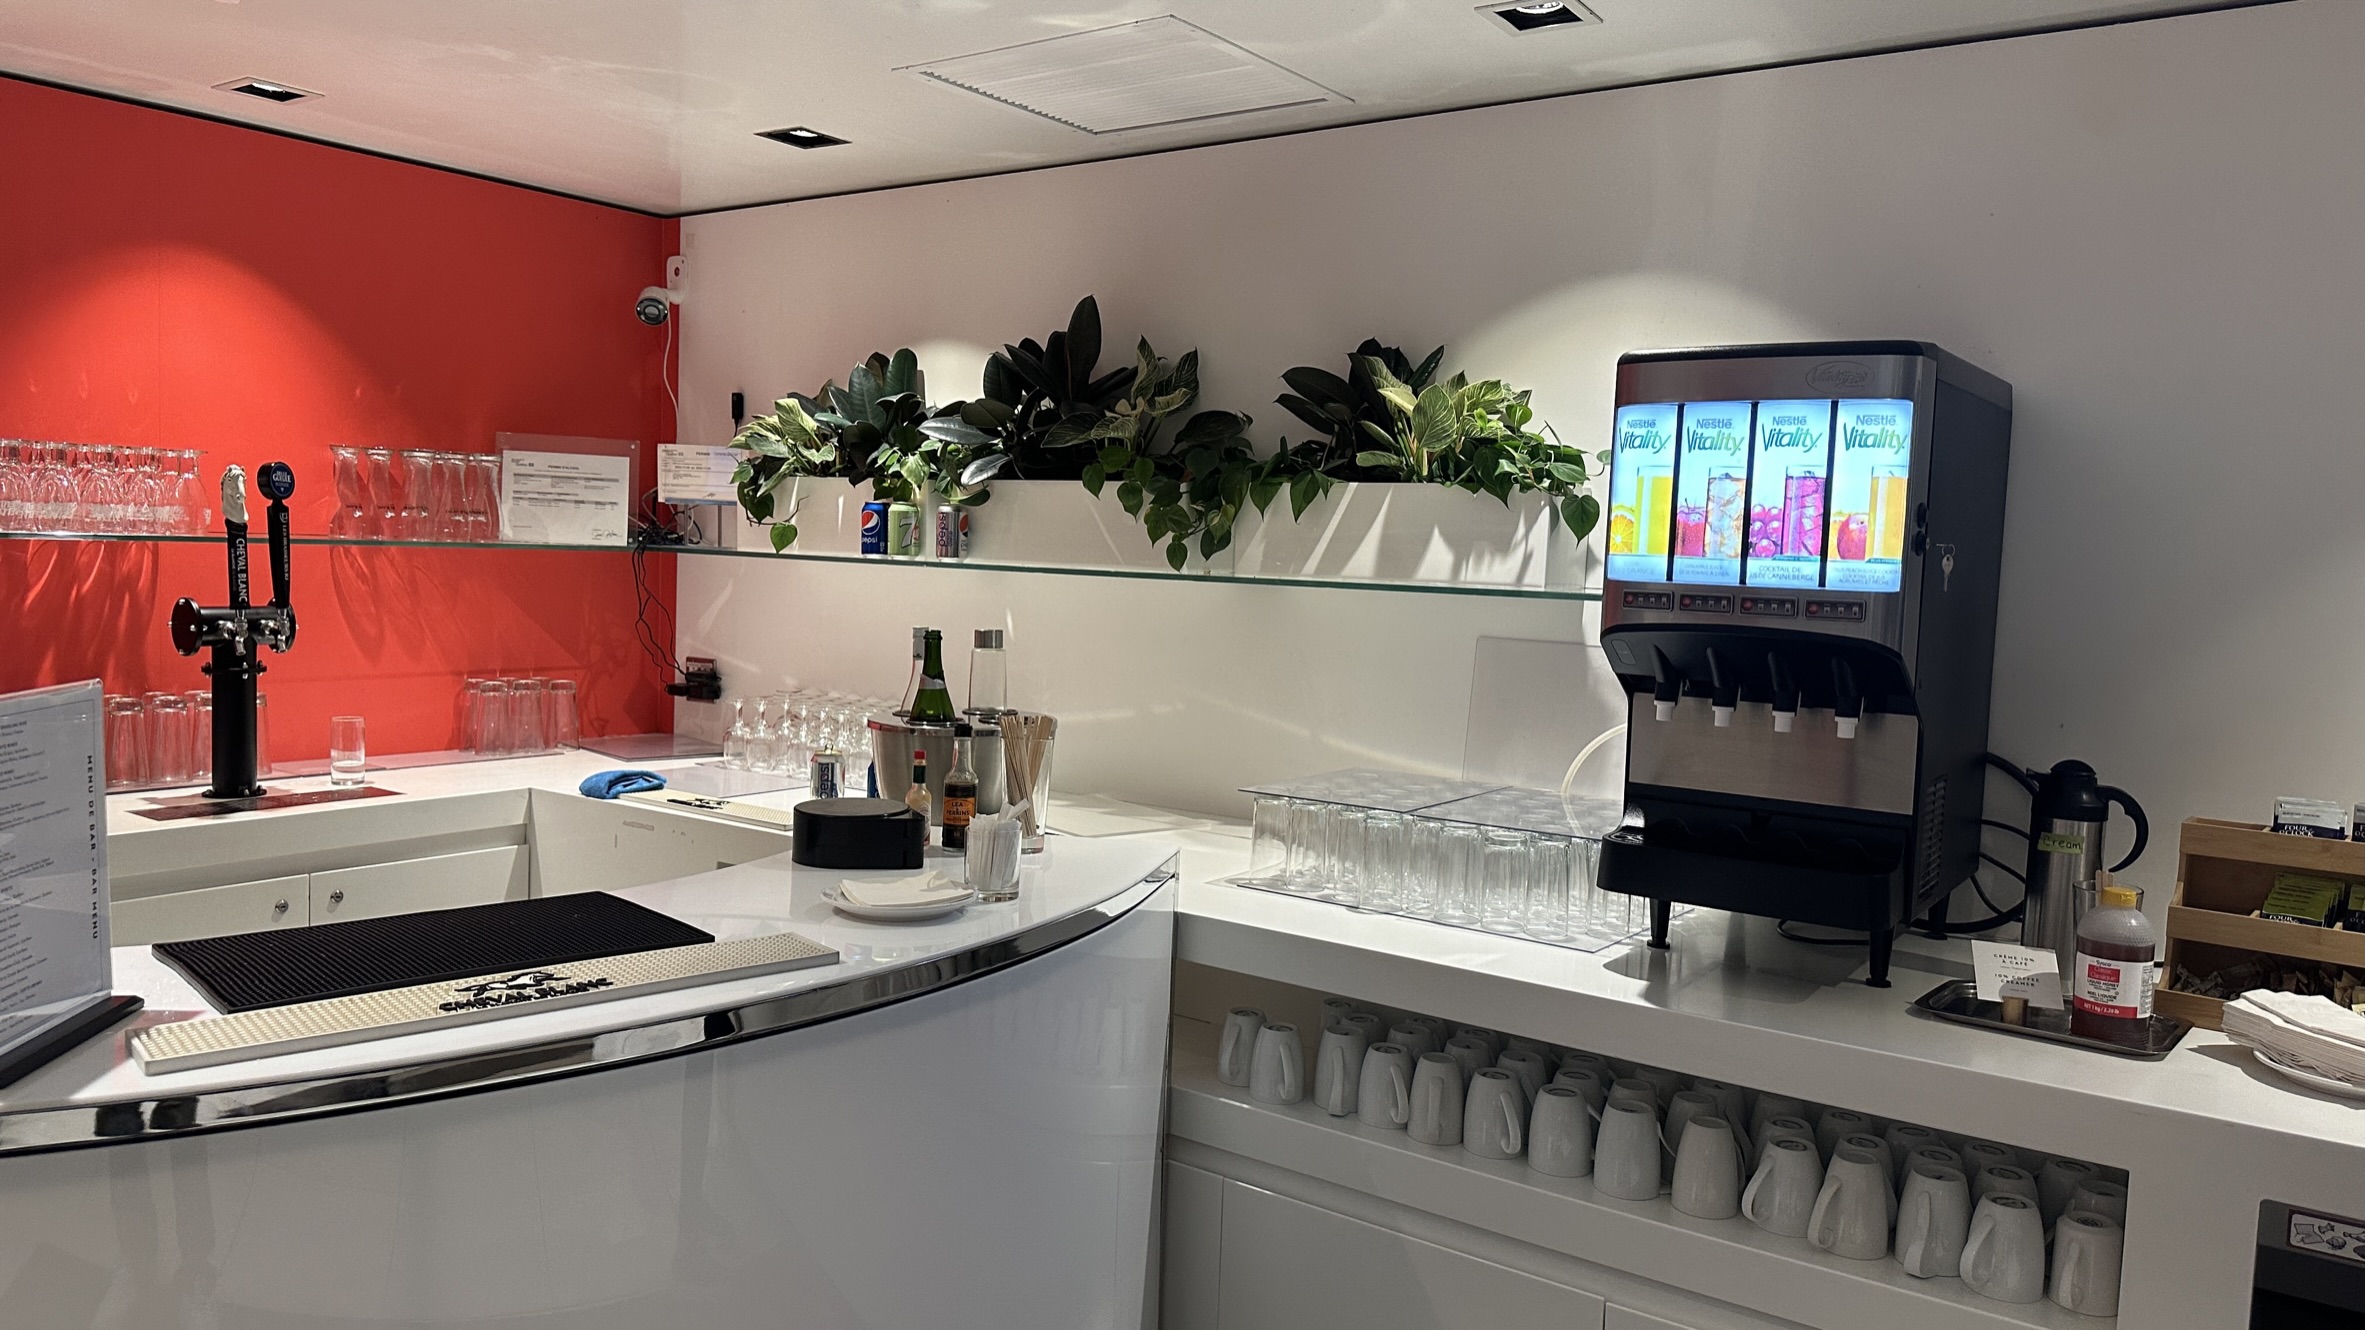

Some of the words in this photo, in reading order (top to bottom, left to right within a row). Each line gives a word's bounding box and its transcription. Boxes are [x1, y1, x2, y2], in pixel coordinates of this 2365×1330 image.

[1626, 418, 1657, 430] Nestlé
[1696, 418, 1734, 430] Nestlé
[1772, 415, 1808, 426] Nestlé
[1855, 414, 1897, 426] Nestlé
[1618, 426, 1672, 455] Vitality
[1686, 425, 1745, 457] Vitality
[1761, 422, 1823, 454] Vitality
[1842, 421, 1909, 455] Vitality
[938, 511, 949, 547] pepsi
[236, 538, 247, 571] CHEVAL
[1758, 565, 1790, 573] COCKTAIL
[1767, 573, 1815, 582] CANNEBERGE
[238, 573, 248, 603] BLANC
[88, 800, 95, 818] DE
[2284, 824, 2308, 832] FOUR
[2042, 834, 2082, 850] Cream
[2095, 959, 2112, 967] Sysco
[2000, 978, 2036, 987] CREAMER
[2011, 975, 2040, 983] COFFEE
[438, 990, 533, 1012] CHEVAL
[532, 977, 614, 999] BLANC
